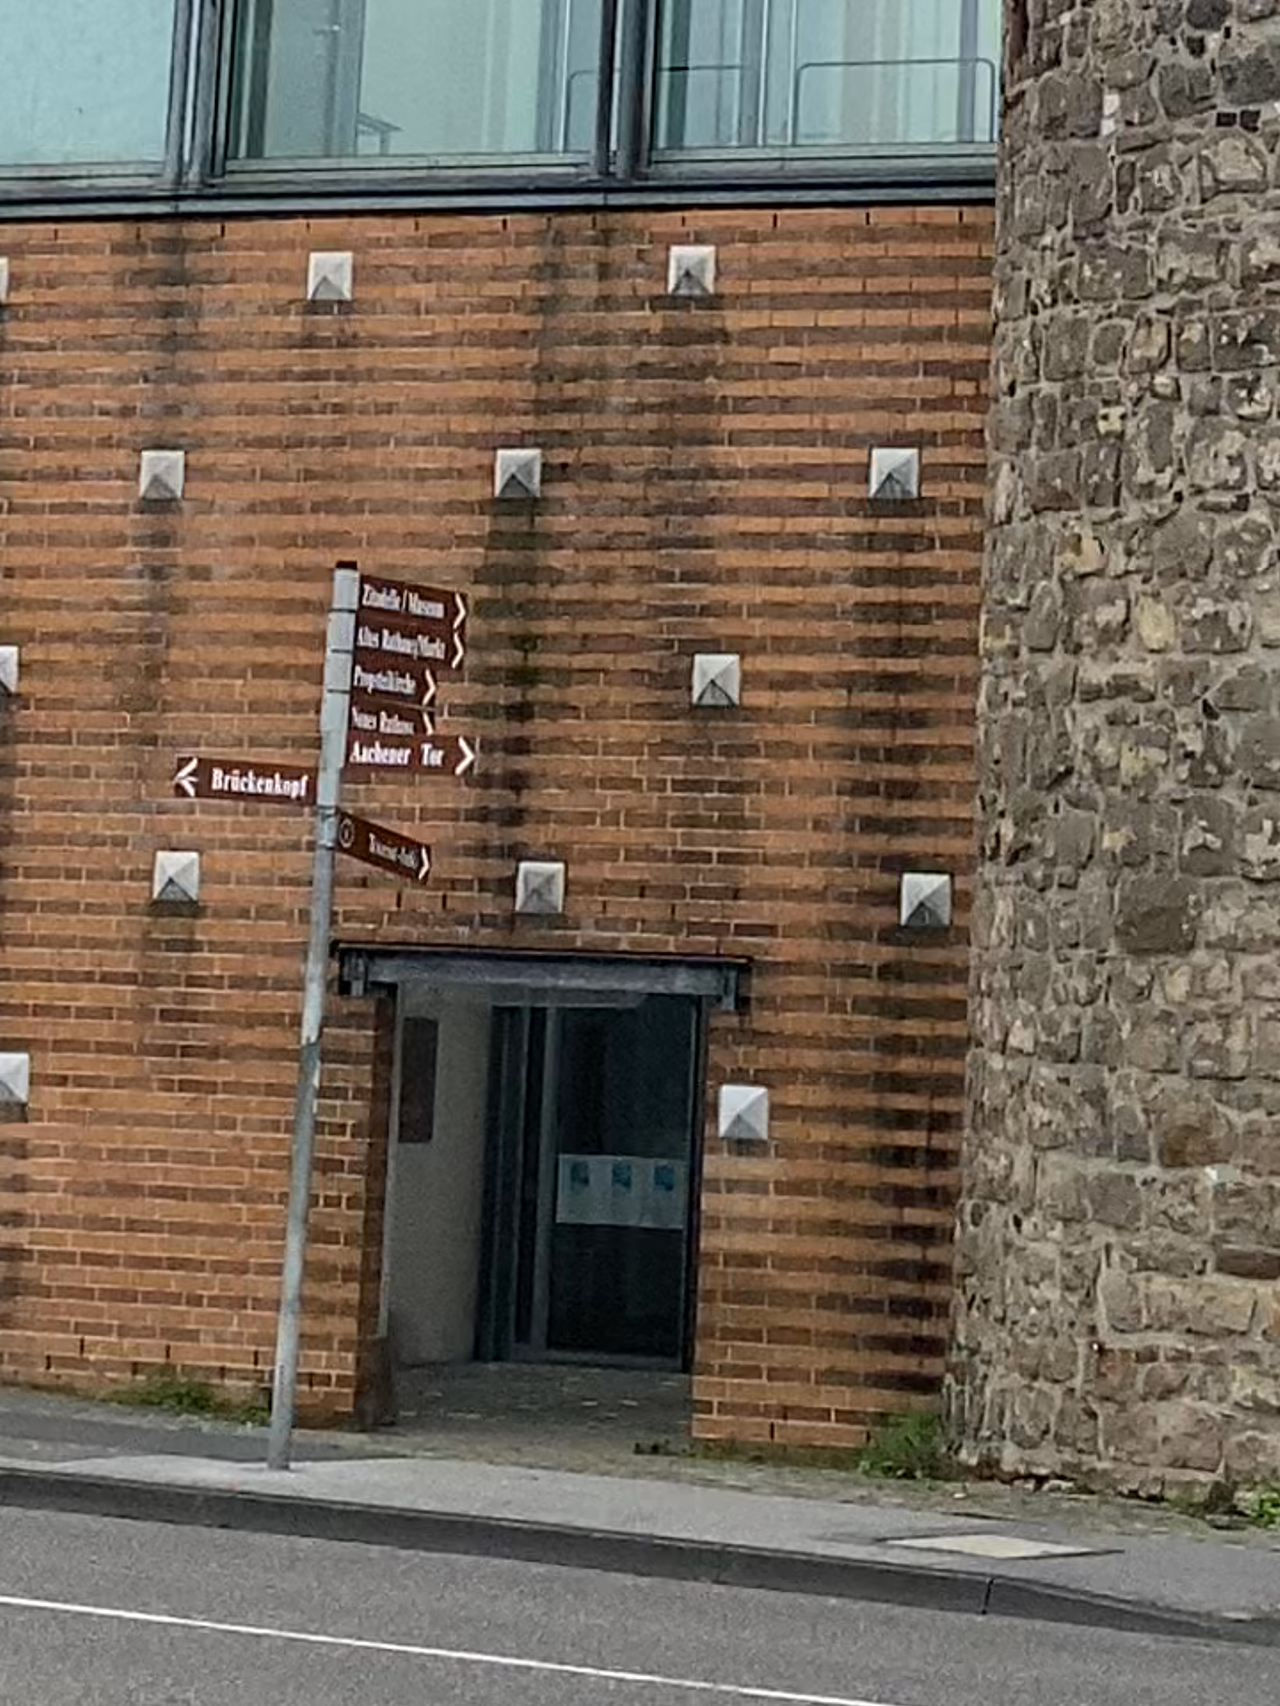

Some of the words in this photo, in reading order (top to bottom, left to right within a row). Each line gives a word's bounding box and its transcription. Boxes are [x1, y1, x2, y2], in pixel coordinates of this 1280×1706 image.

[349, 740, 411, 765] Aachener
[421, 743, 444, 767] Tor
[211, 767, 308, 799] Brückenkopf
